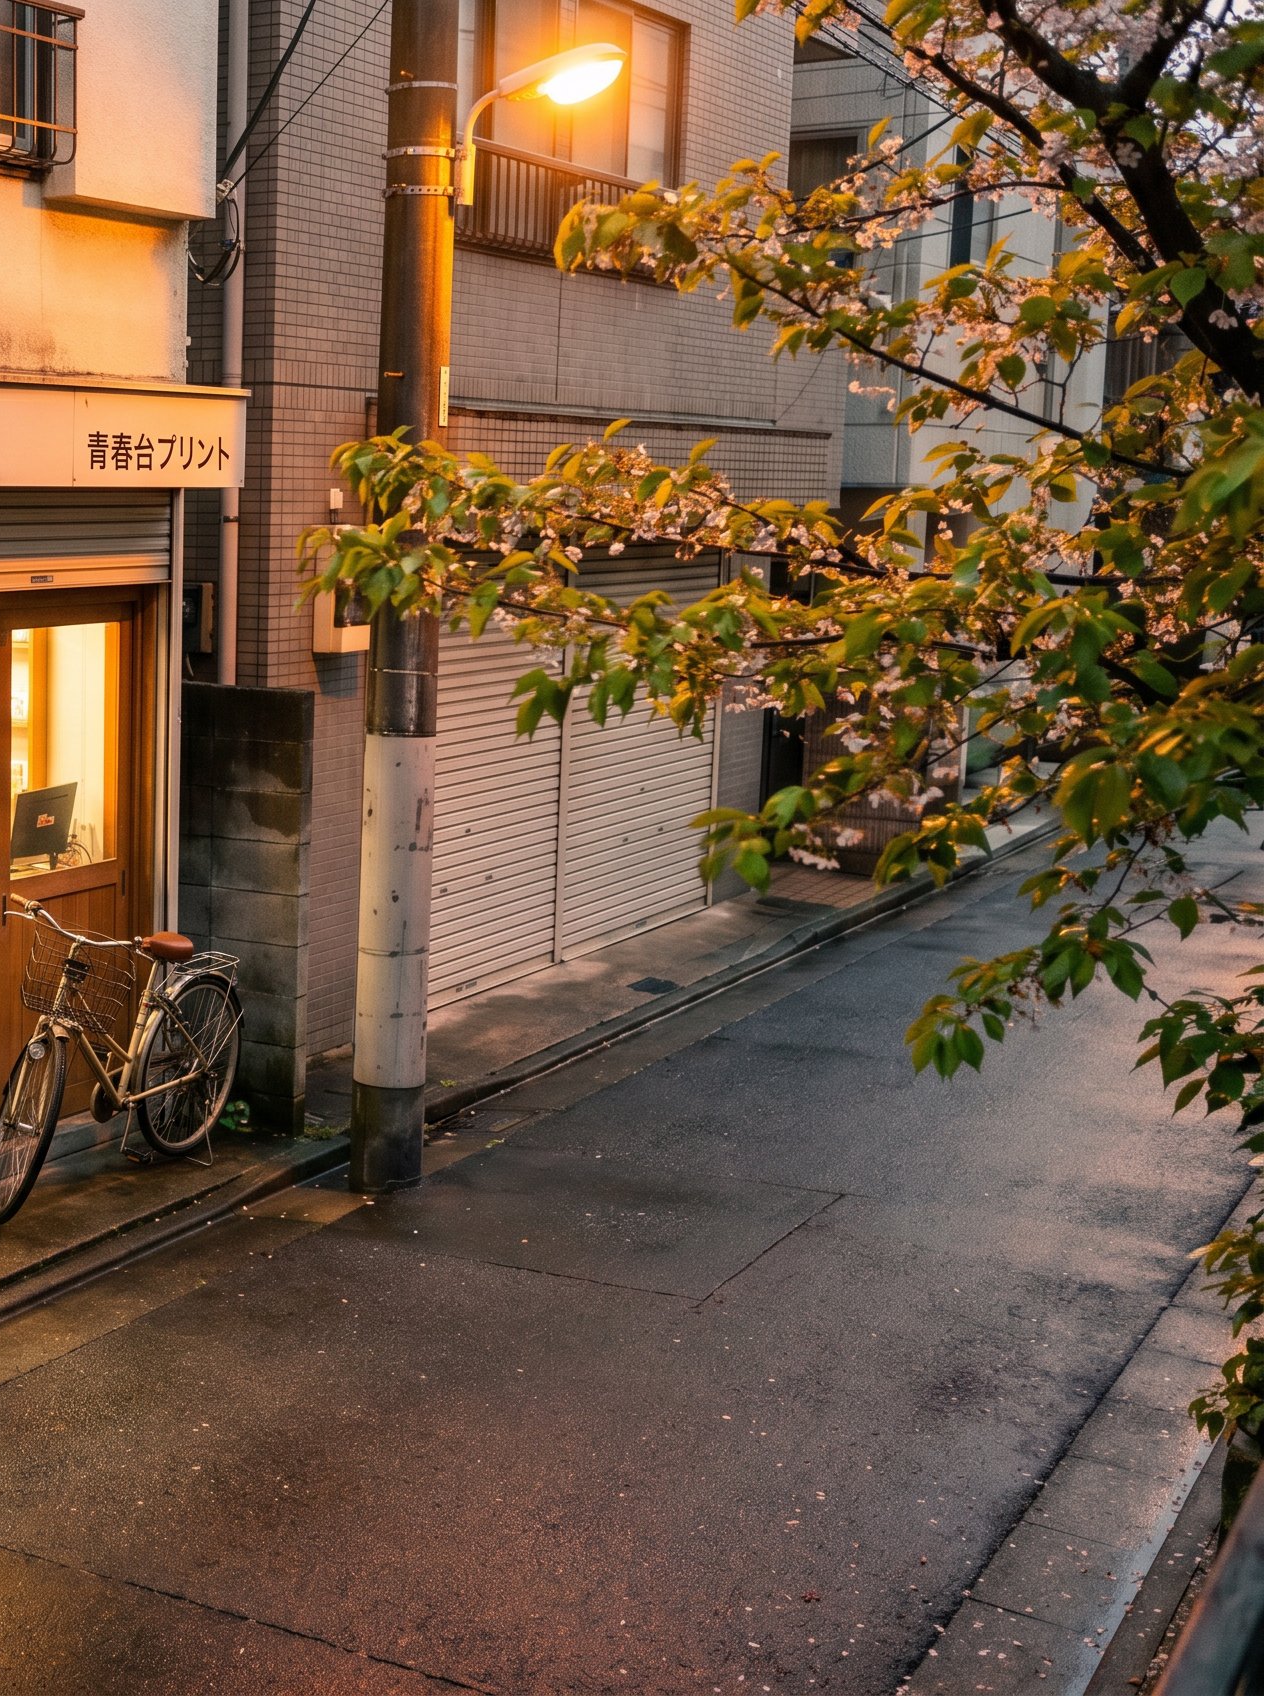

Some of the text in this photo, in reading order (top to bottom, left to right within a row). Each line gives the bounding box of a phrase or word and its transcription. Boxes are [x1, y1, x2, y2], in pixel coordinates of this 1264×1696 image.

[87, 431, 230, 471] 青春台プリント
